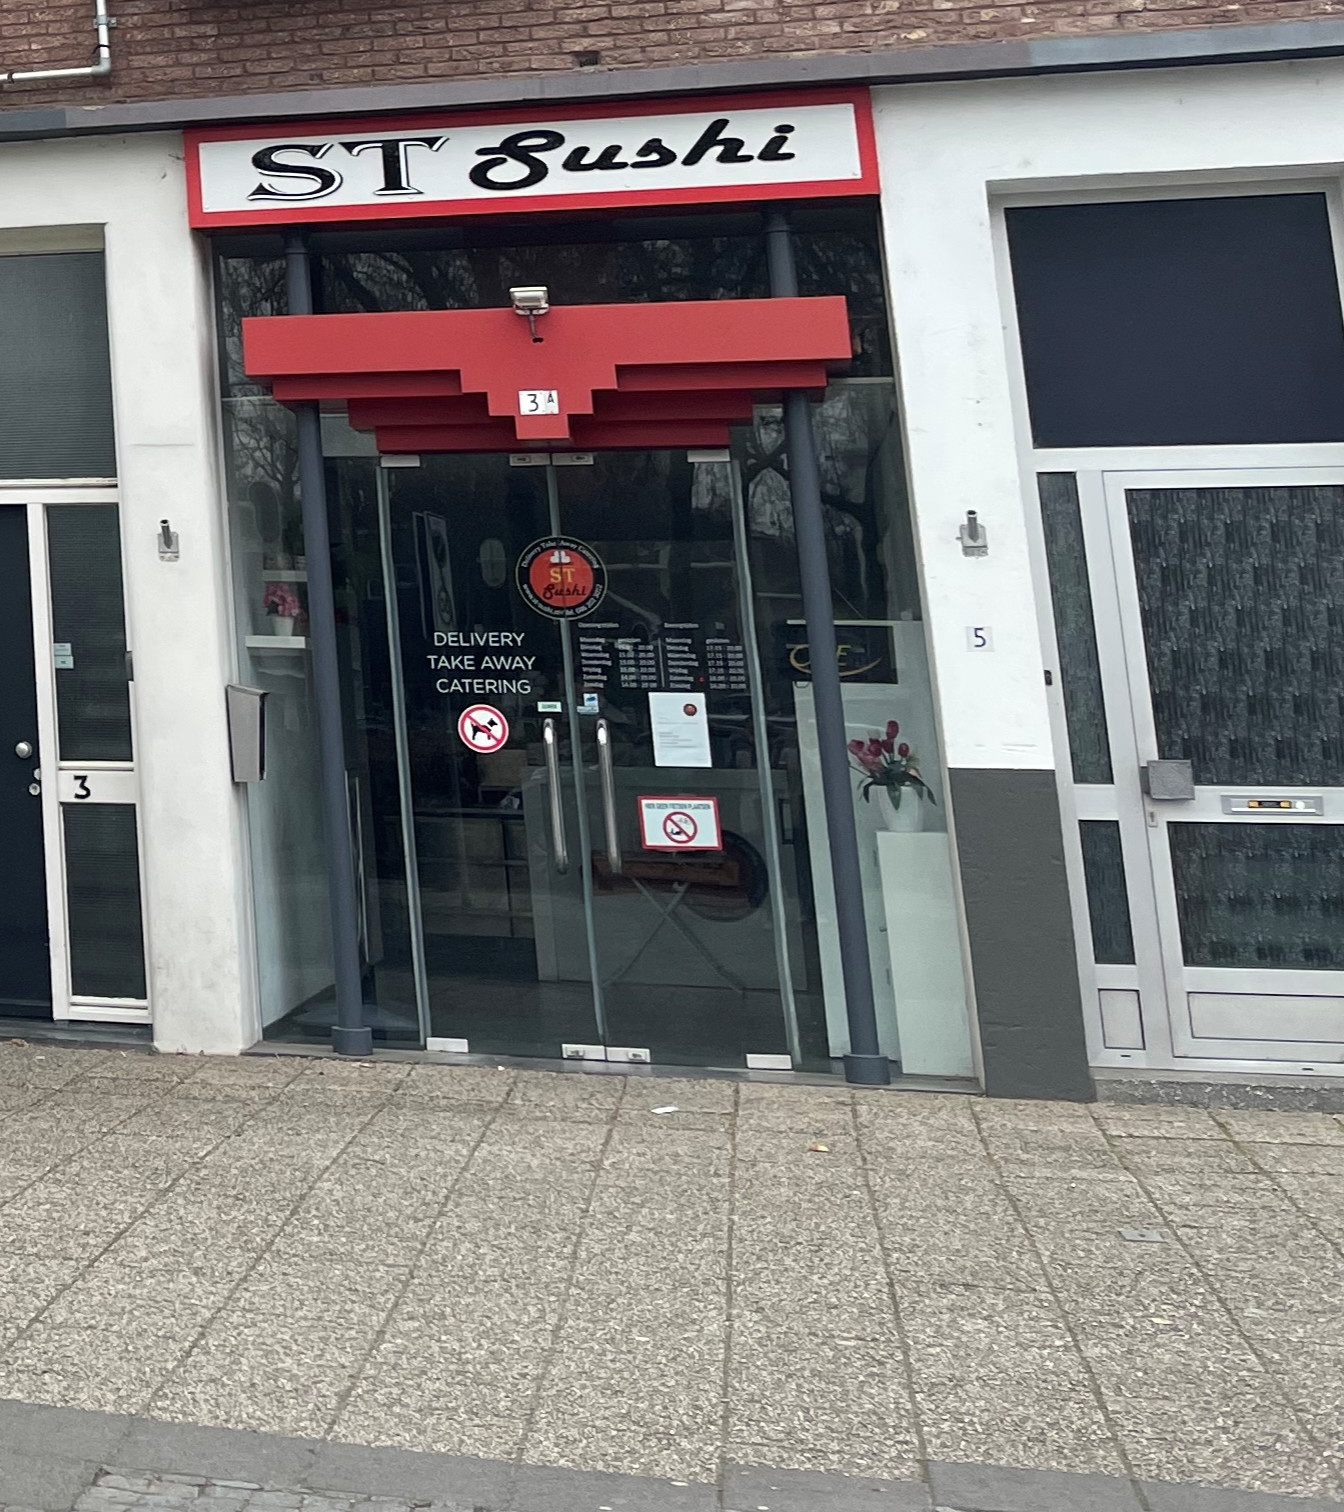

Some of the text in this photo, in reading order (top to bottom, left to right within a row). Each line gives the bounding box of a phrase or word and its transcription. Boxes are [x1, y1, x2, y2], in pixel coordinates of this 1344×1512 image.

[248, 118, 796, 201] ST Sushi
[526, 392, 555, 412] 3 A
[550, 568, 576, 583] ST
[543, 584, 587, 600] Sushi
[433, 632, 525, 647] DELIVERY
[974, 627, 986, 648] 5
[426, 655, 536, 670] TAKE AWAY
[435, 679, 532, 694] CATERING
[73, 775, 91, 800] 3
